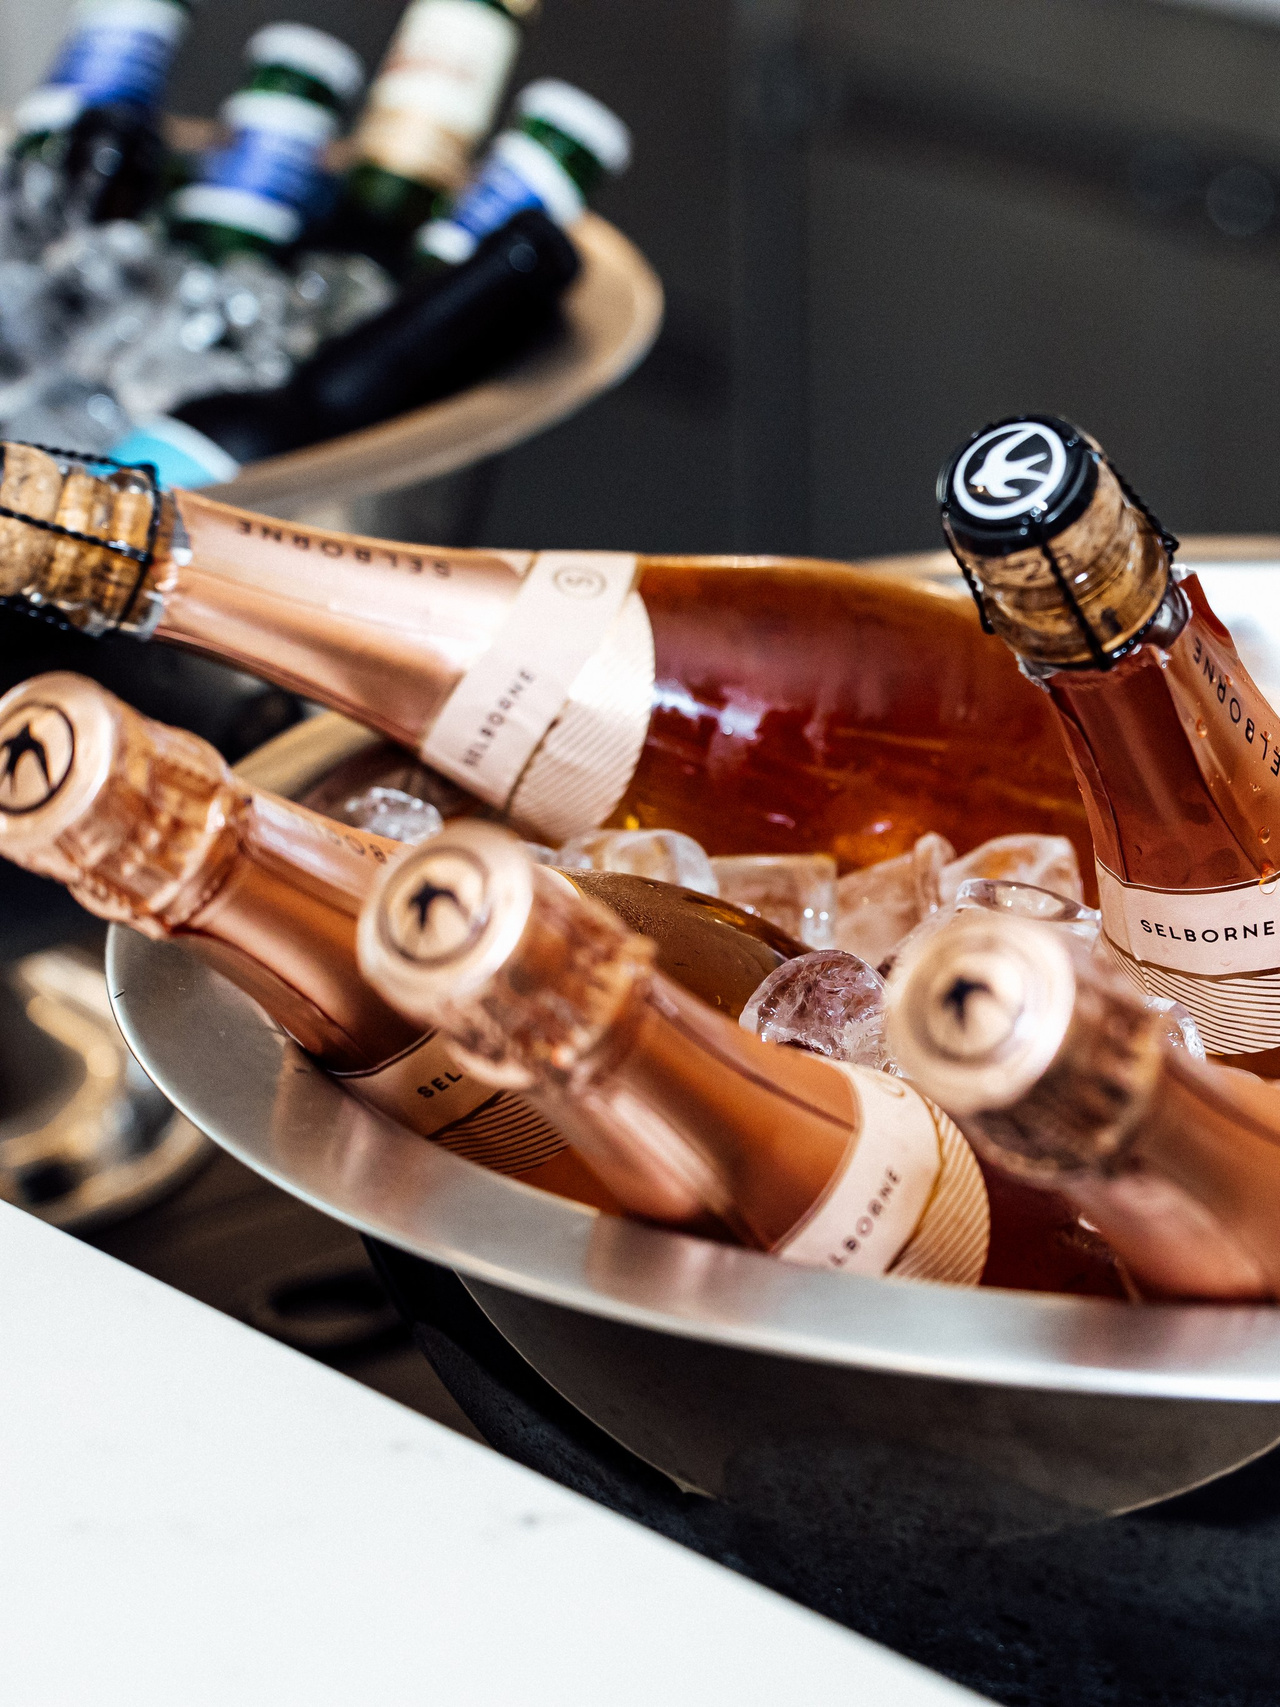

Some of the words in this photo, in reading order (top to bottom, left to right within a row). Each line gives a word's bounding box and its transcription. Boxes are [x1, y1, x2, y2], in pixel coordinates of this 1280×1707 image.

[238, 518, 450, 578] SELBORNE
[463, 668, 534, 768] SELBORNE
[1140, 919, 1275, 943] SELBORNE
[828, 1165, 900, 1267] LBORNE
